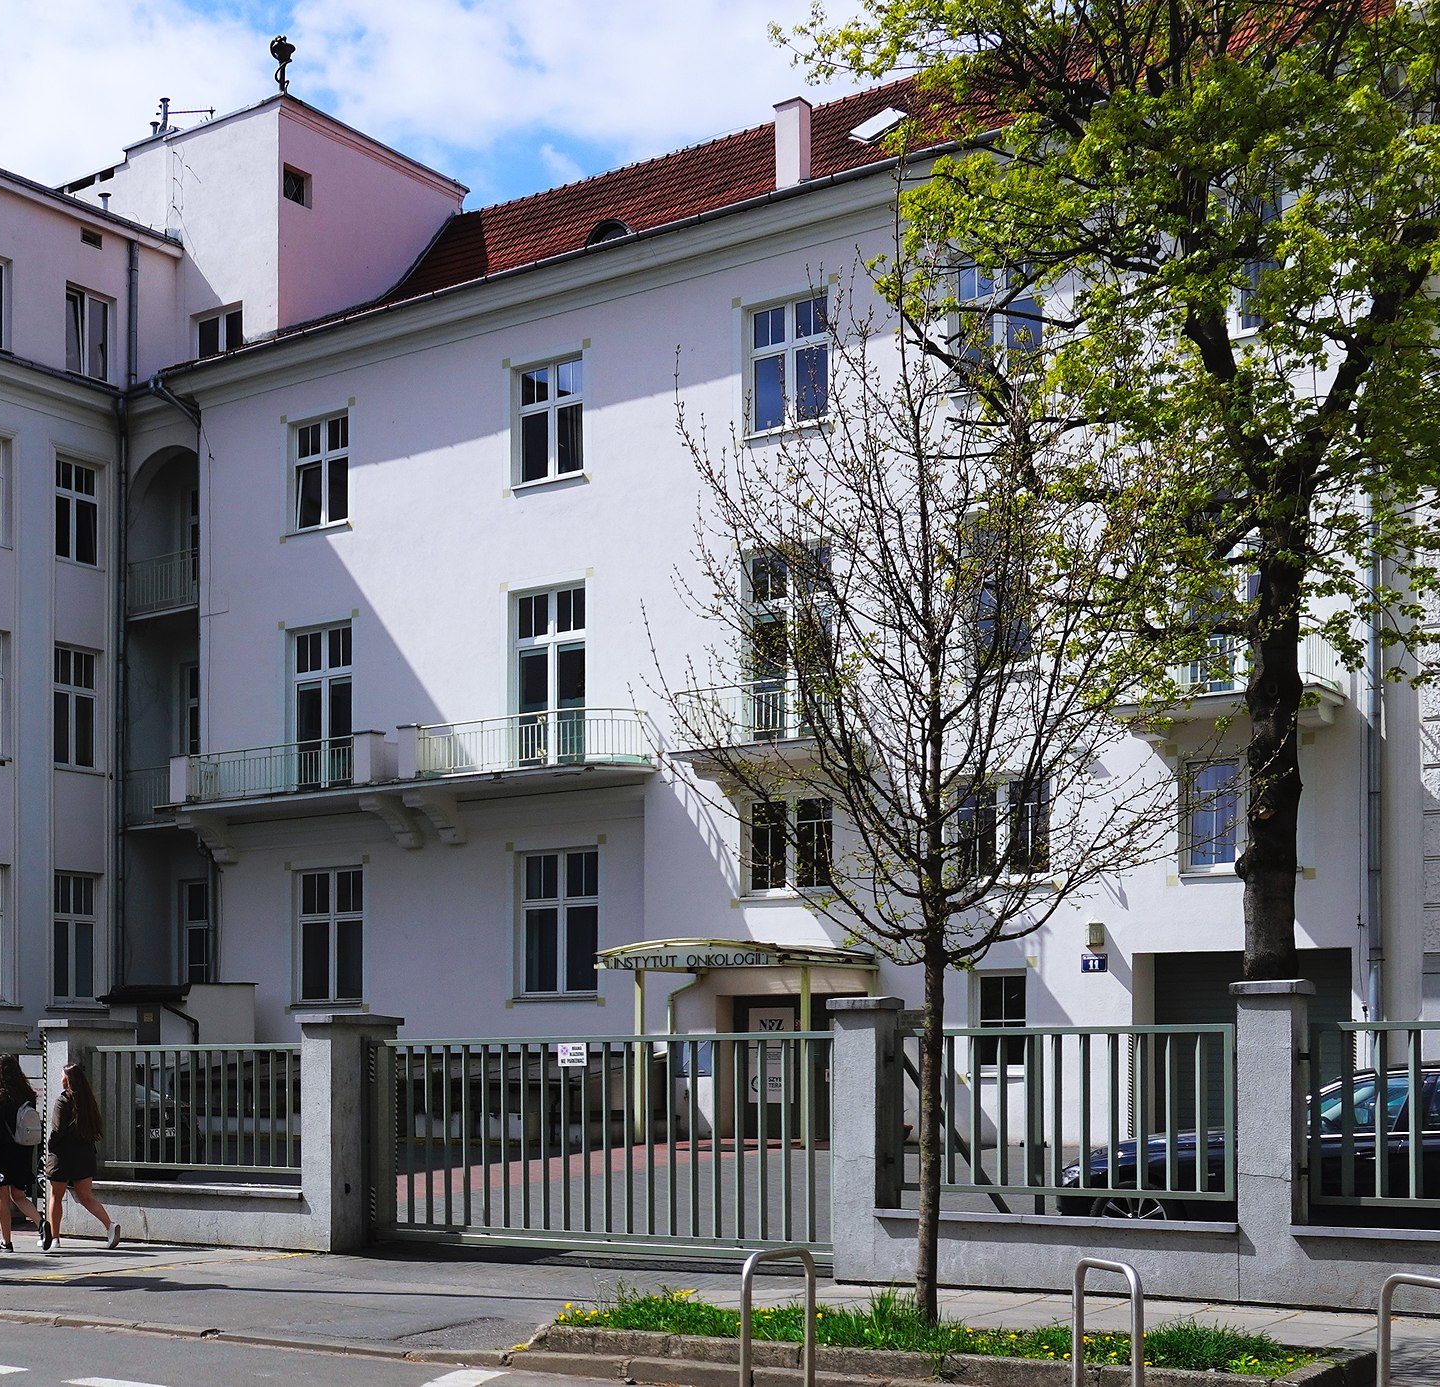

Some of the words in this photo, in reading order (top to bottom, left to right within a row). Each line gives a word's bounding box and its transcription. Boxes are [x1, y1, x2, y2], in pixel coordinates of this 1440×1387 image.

[614, 955, 677, 968] INSTYTUT
[687, 953, 761, 967] ONKOLOGII
[1088, 959, 1100, 970] 11
[760, 1019, 785, 1031] NFZ
